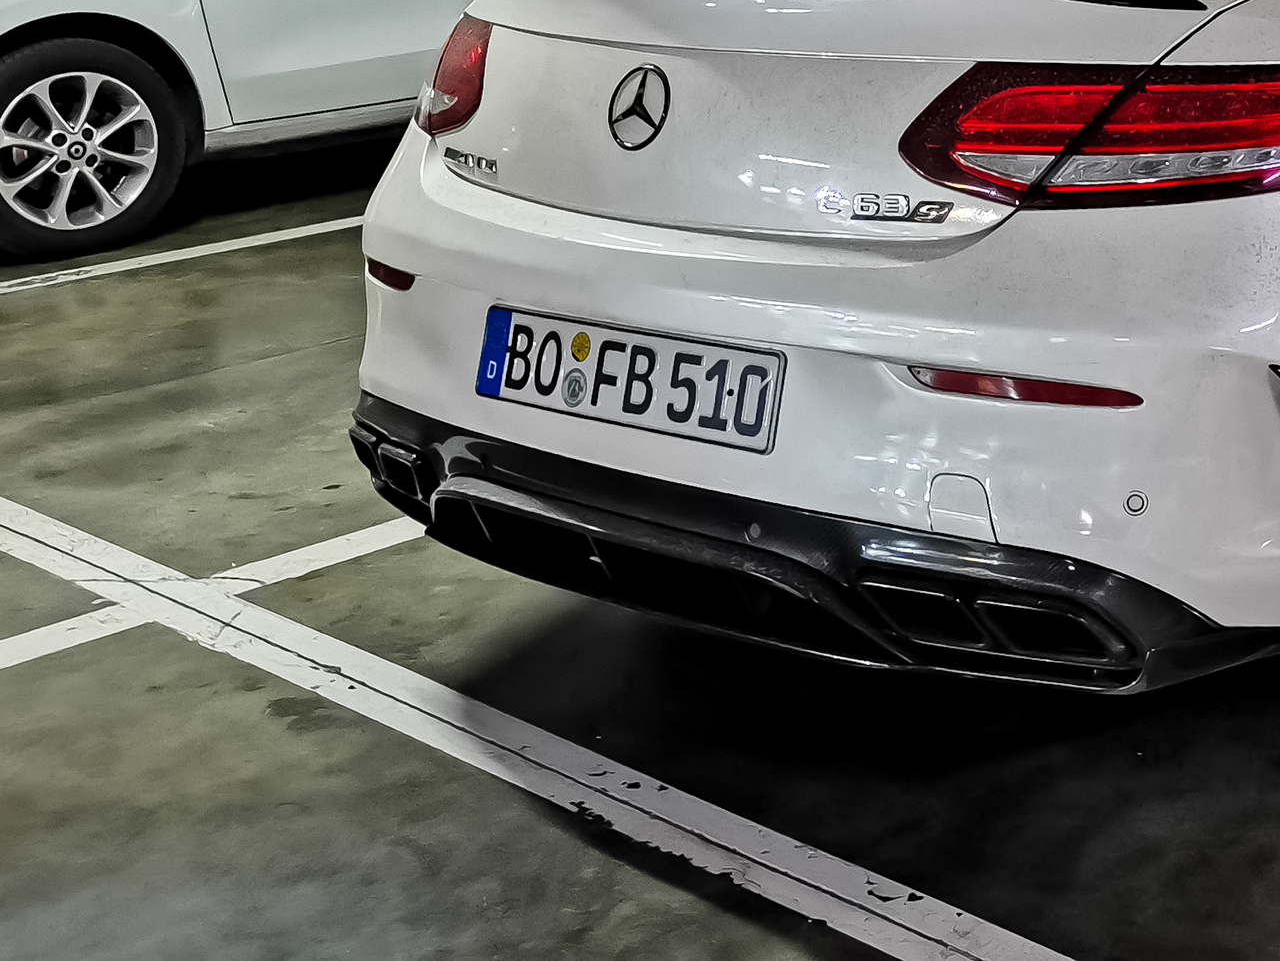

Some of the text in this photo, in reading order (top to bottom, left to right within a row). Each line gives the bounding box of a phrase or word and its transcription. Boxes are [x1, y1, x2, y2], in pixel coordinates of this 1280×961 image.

[487, 360, 497, 379] D
[504, 324, 771, 437] BO FB 510
